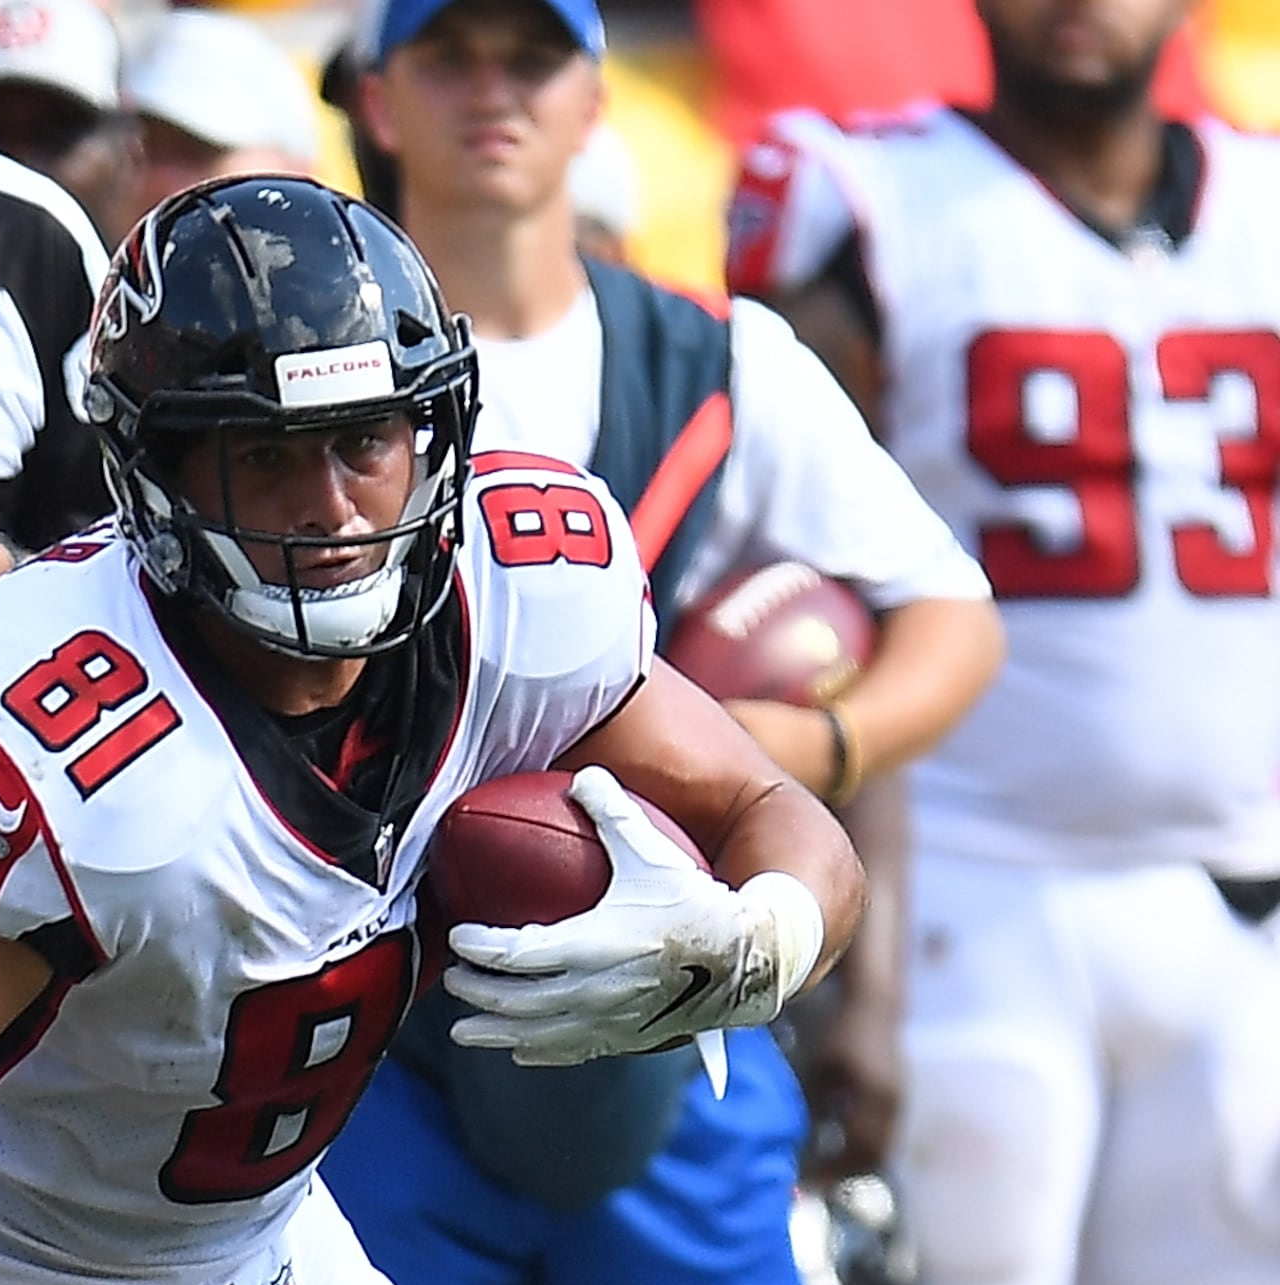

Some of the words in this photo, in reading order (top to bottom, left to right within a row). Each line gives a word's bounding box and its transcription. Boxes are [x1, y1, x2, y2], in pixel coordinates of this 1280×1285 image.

[286, 359, 382, 382] FALCONS
[966, 328, 1280, 602] 93
[0, 628, 184, 803] 81
